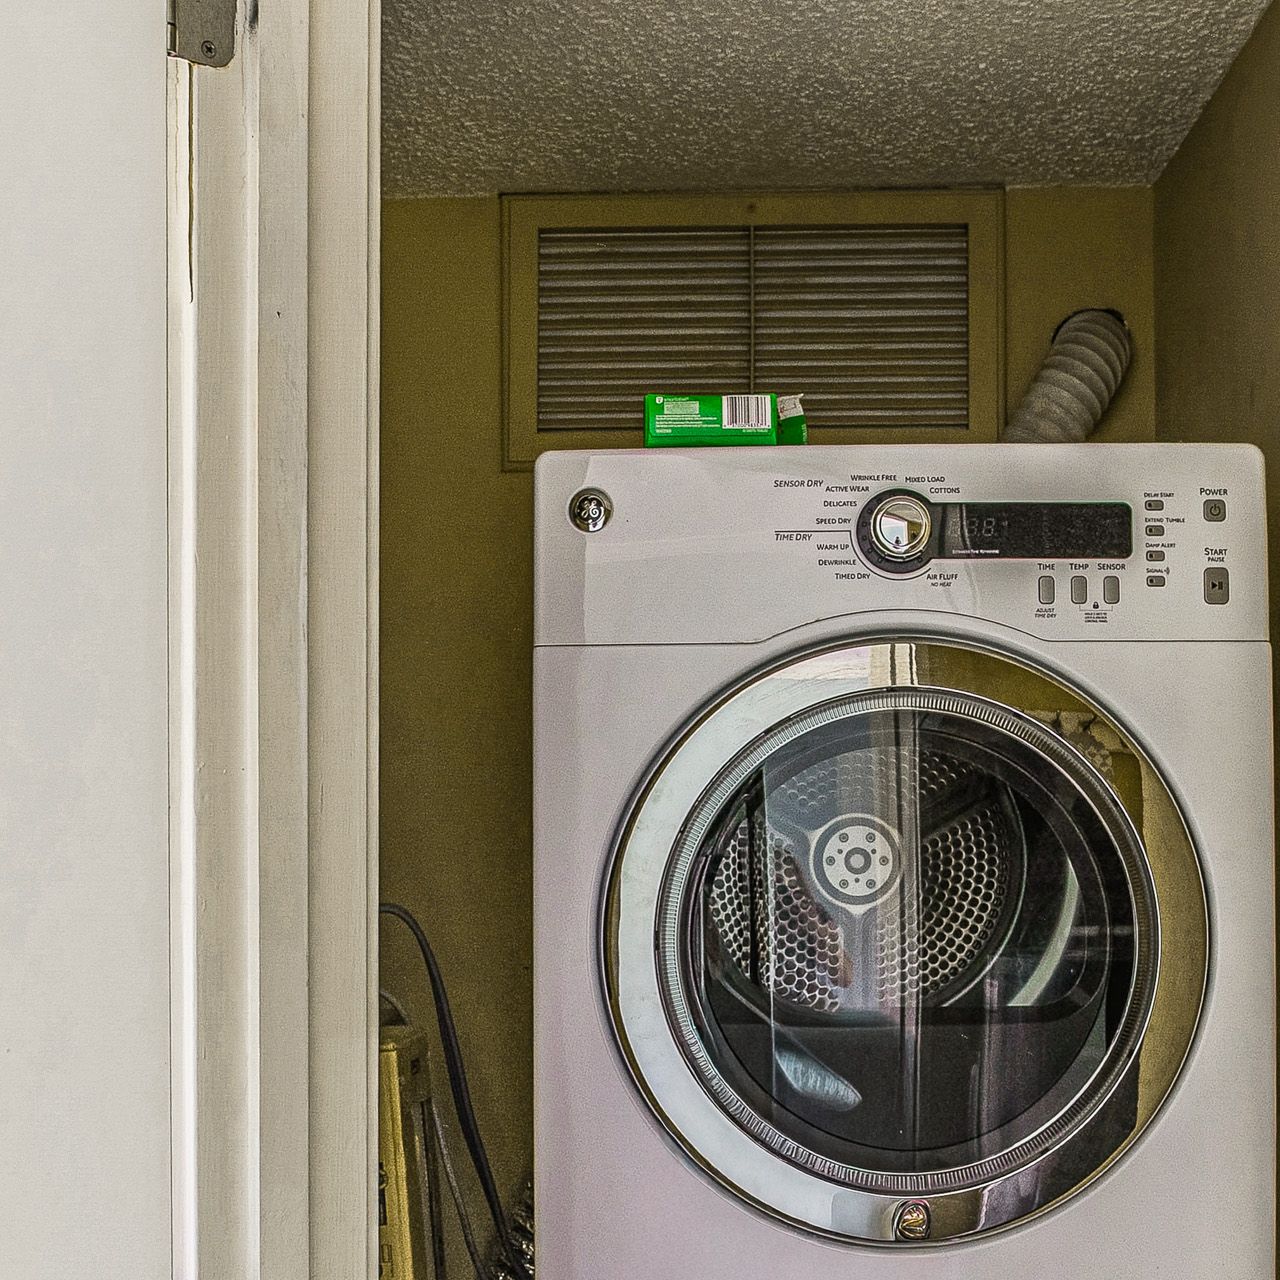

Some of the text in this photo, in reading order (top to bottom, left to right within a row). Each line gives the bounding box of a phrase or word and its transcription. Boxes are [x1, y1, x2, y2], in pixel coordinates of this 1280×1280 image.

[774, 480, 823, 488] SENSOR DRY
[1200, 488, 1228, 496] POWER
[1204, 548, 1227, 556] START
